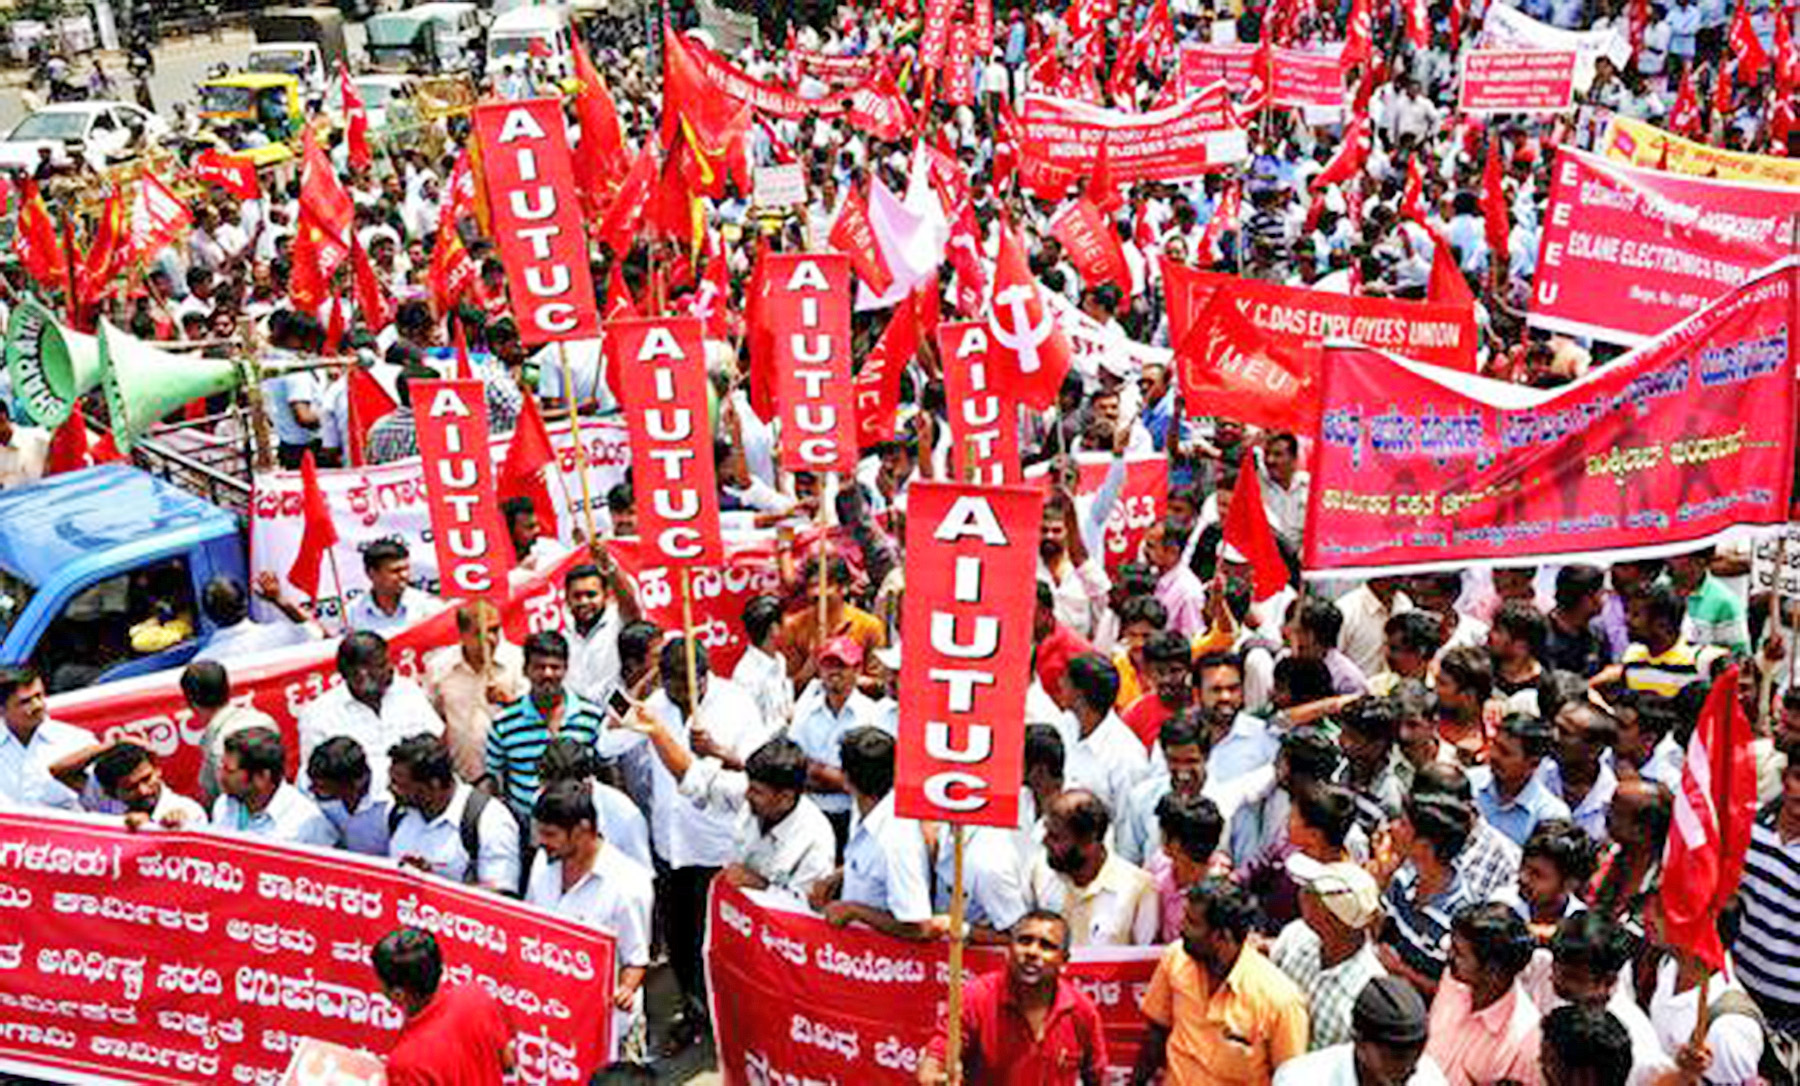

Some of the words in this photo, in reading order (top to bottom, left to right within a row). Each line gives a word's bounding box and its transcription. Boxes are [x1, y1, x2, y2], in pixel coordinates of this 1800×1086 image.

[497, 107, 581, 333] AIUTUC
[1309, 309, 1406, 344] EMPLOYEES
[1408, 321, 1461, 347] UNION
[637, 319, 704, 557] AIUTUC
[785, 259, 841, 465] AIUTUC
[428, 379, 491, 591] AIUTUC
[924, 496, 1008, 812] AIUTUC
